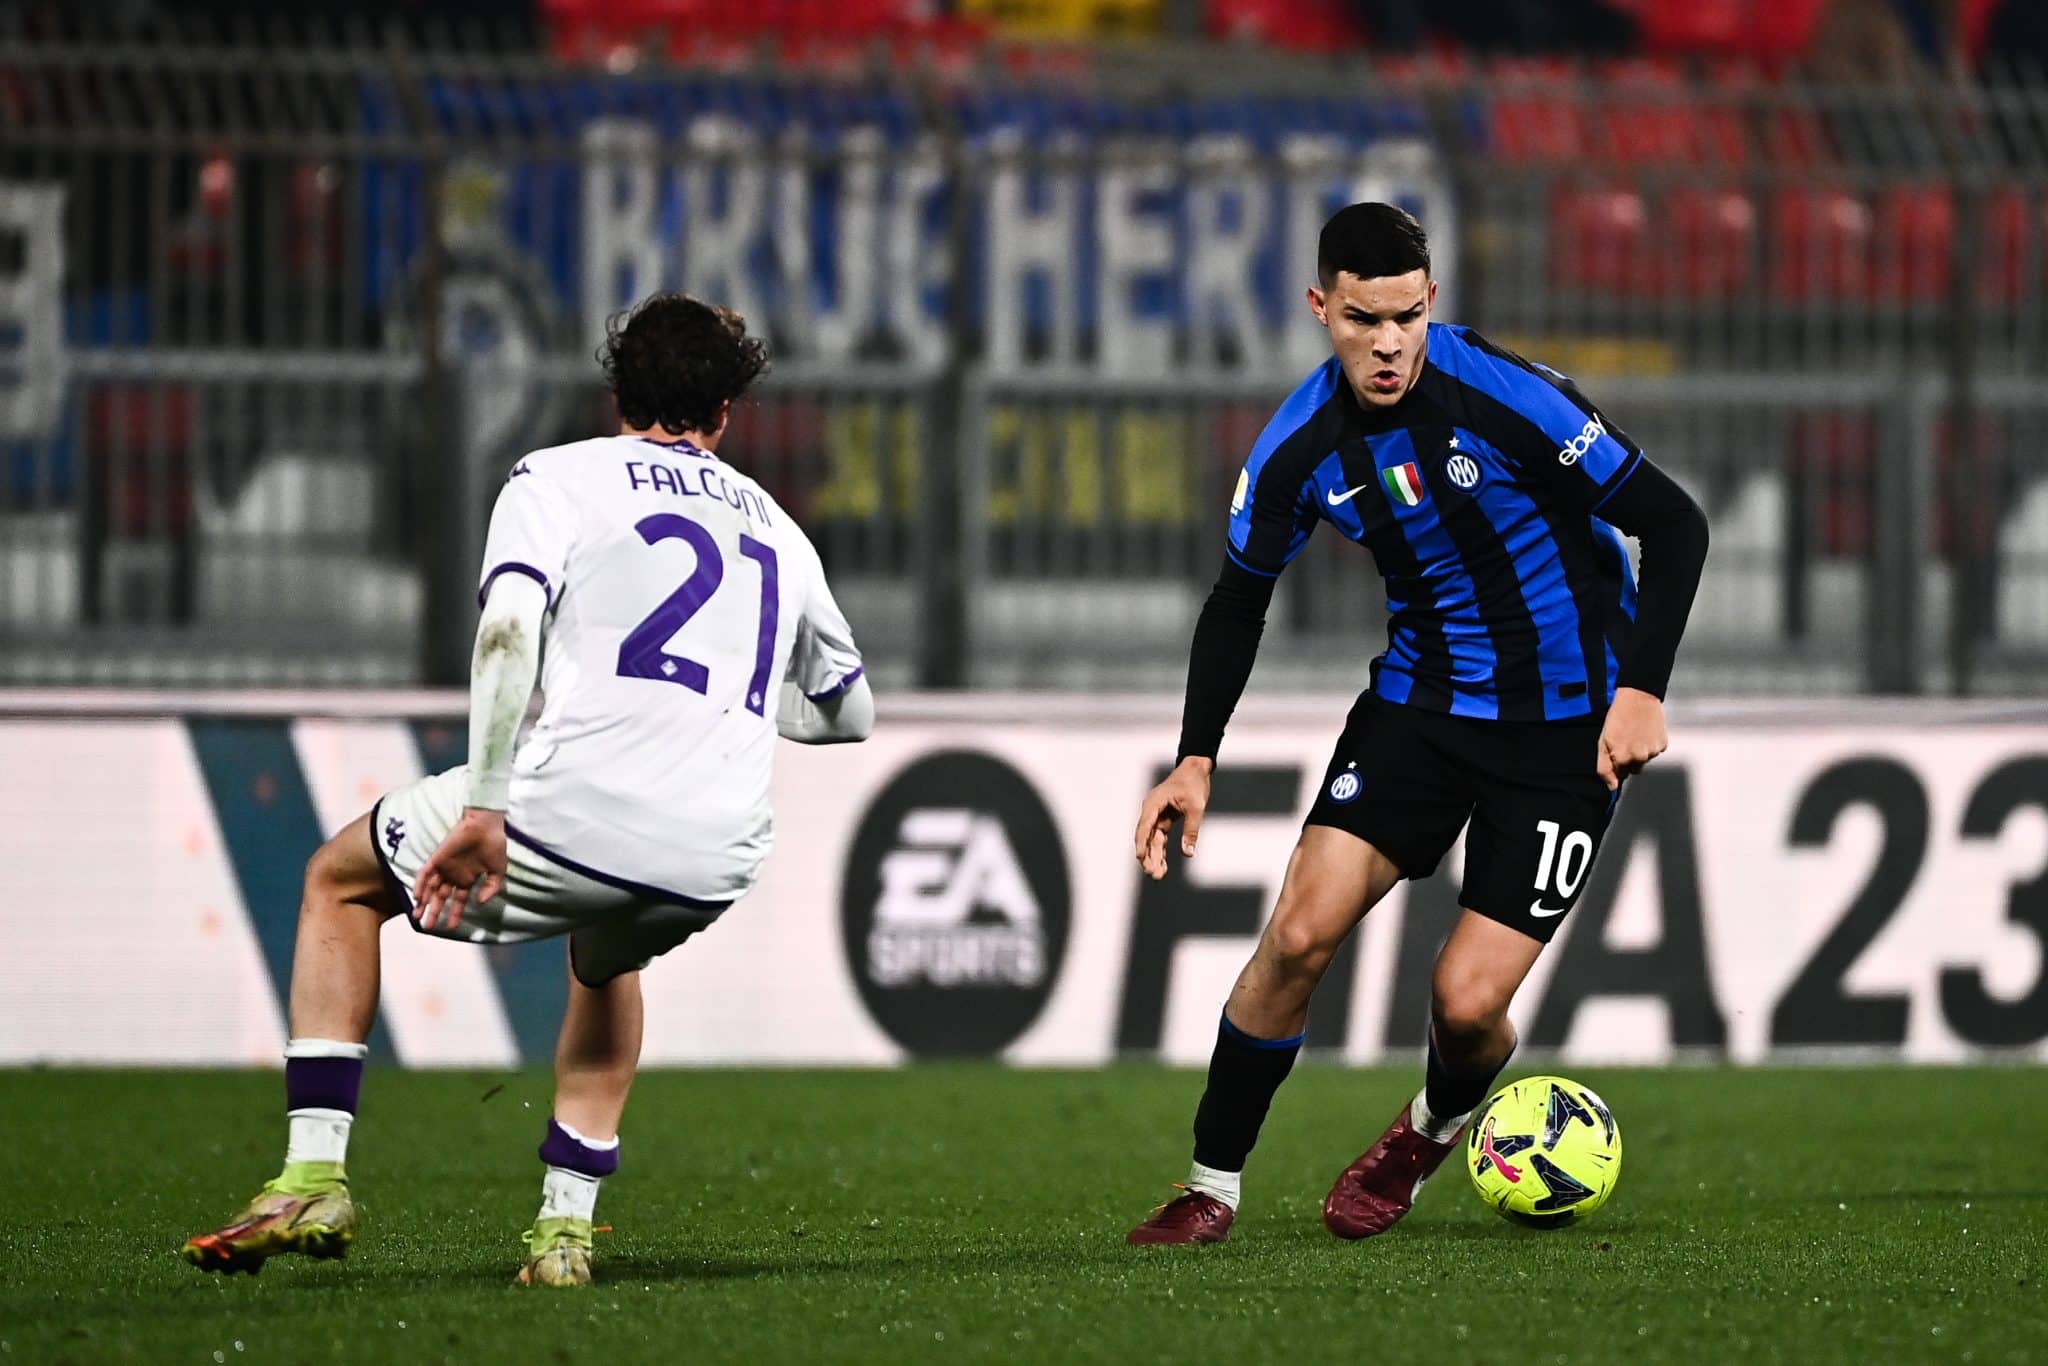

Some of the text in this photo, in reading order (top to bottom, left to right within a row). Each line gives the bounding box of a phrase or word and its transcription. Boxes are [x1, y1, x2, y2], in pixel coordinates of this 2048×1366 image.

[1558, 411, 1607, 466] ebay
[625, 460, 772, 528] FALCONI
[615, 512, 780, 718] 21
[877, 807, 1040, 926] EA
[1533, 819, 1593, 899] 10
[1769, 753, 2048, 1049] 23
